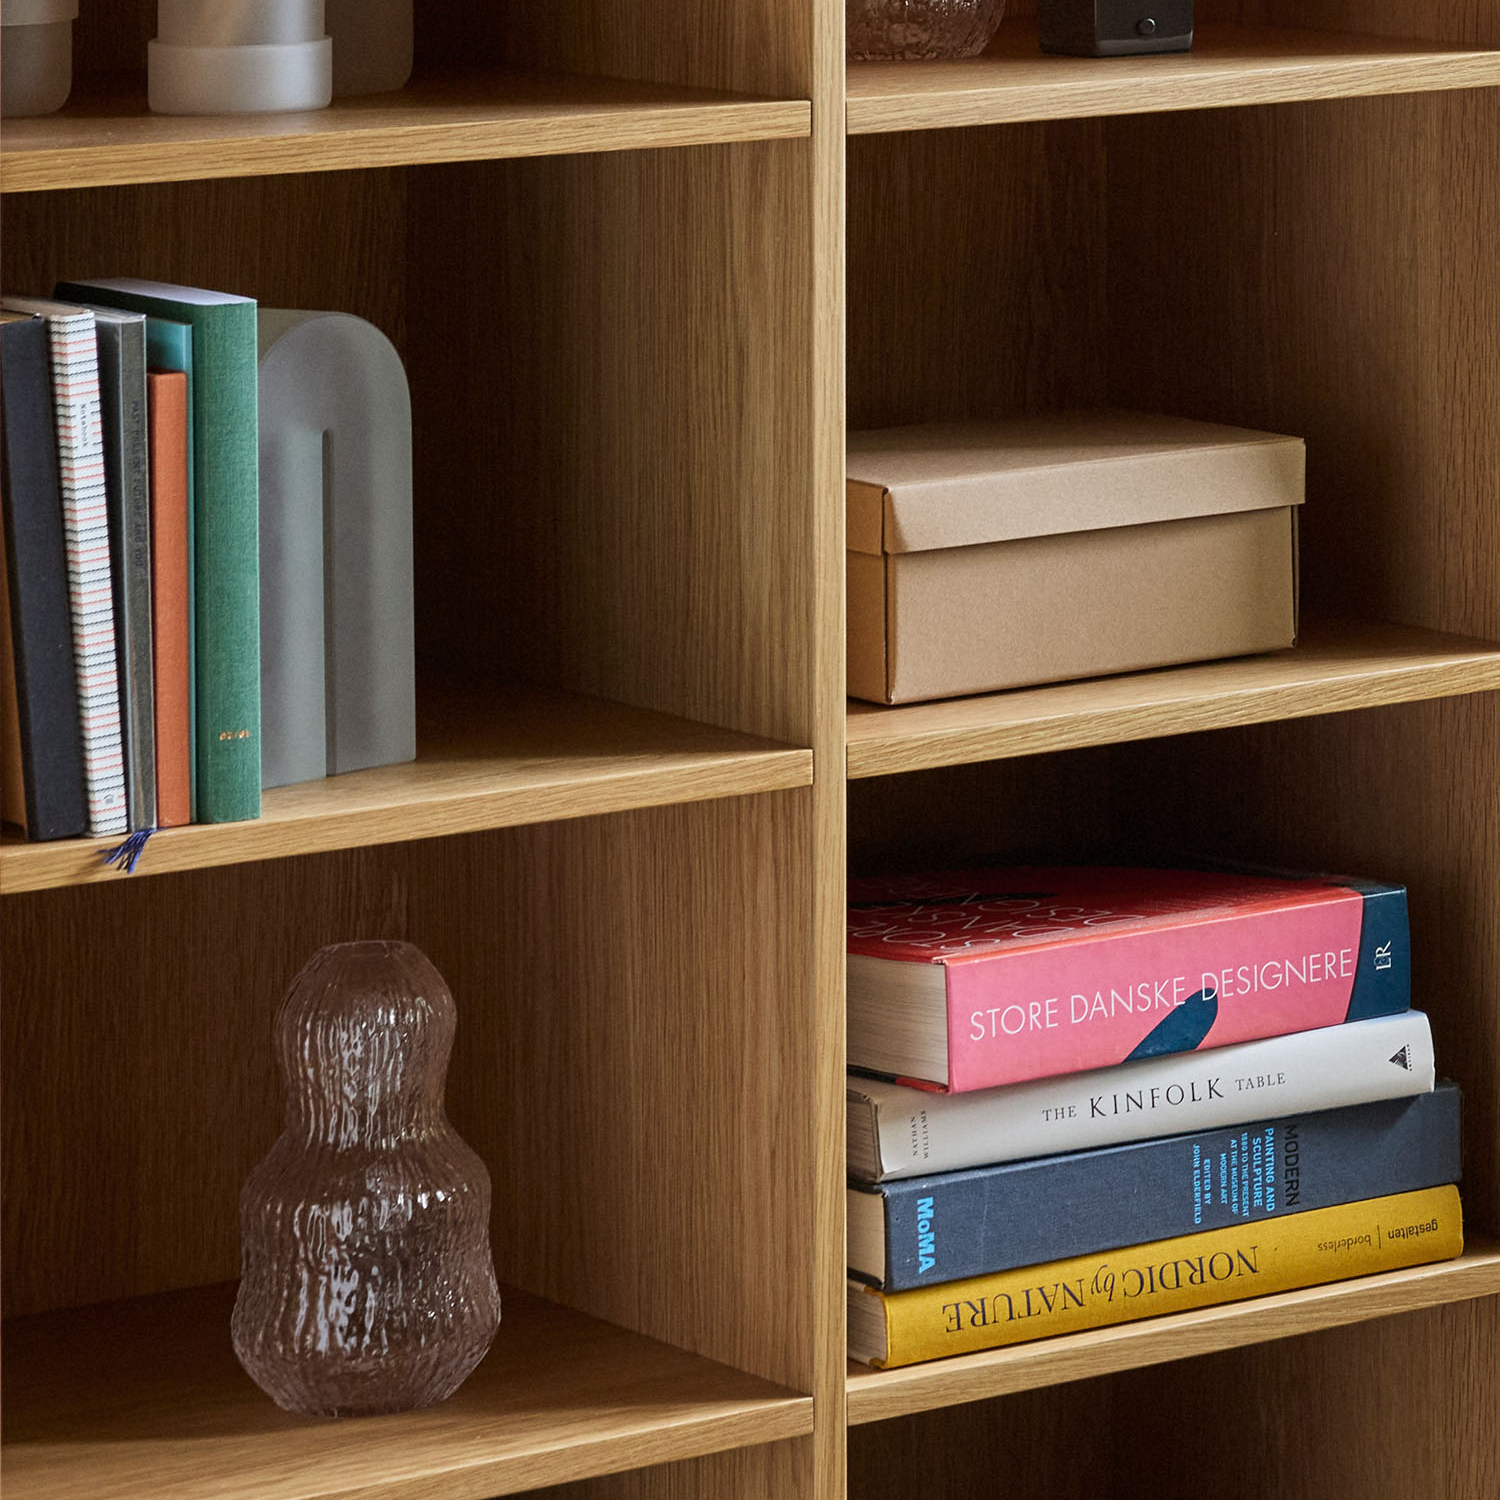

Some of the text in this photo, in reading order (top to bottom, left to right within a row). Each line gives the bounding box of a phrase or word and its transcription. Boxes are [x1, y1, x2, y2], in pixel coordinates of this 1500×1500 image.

[969, 948, 1353, 1042] STORE DANSKE DESIGNERE
[1042, 1072, 1287, 1122] THE KINFOLK TABLE
[910, 1116, 919, 1157] NATHAN
[920, 1110, 929, 1160] WILLIAMS
[1241, 1152, 1248, 1162] TO
[1193, 1143, 1202, 1224] JOHN ELDERFIELD
[1203, 1158, 1212, 1205] EDITED BY
[1220, 1152, 1228, 1204] MODERN ART
[1230, 1139, 1239, 1215] AT THE MUSEUM OF
[1241, 1163, 1249, 1180] THE
[1252, 1136, 1263, 1208] SCULPTURE
[1264, 1127, 1276, 1212] PAINTING AND
[1284, 1123, 1300, 1208] MODERN
[1241, 1180, 1250, 1217] PRESENT
[916, 1196, 936, 1274] MoMA
[1317, 1218, 1439, 1254] gestalten borderless
[942, 1246, 1259, 1333] NORDIC by NATURE
